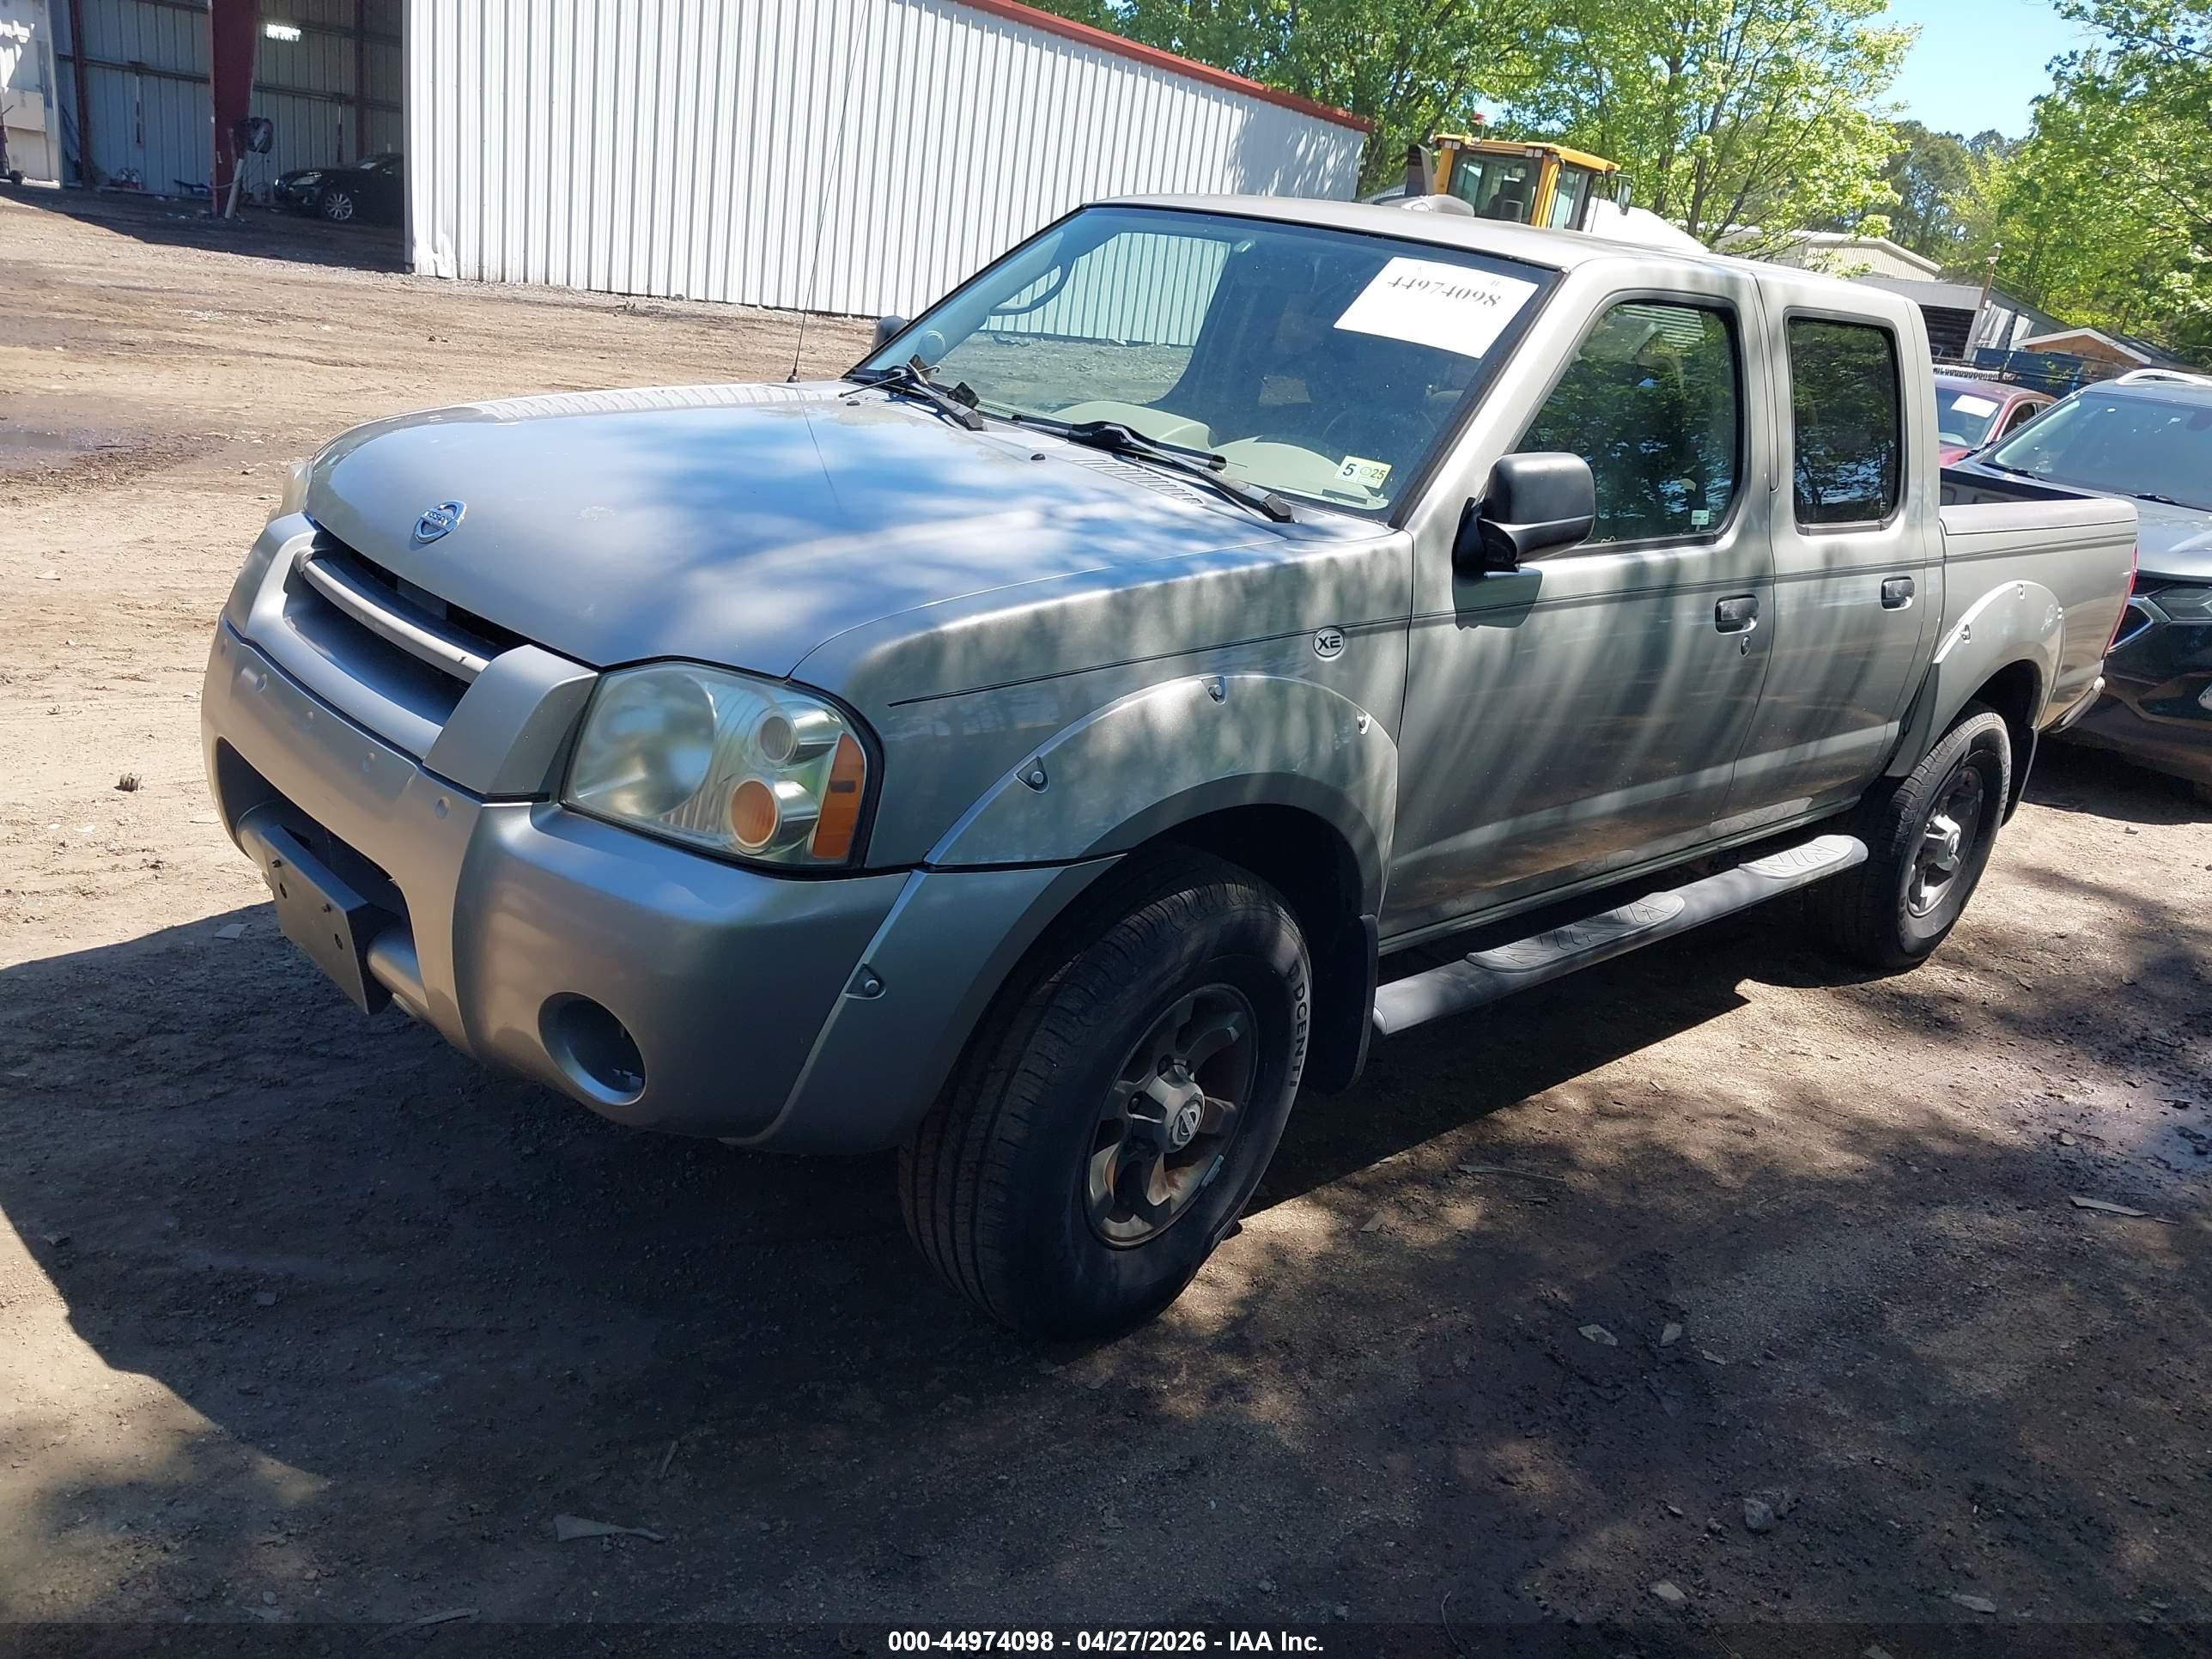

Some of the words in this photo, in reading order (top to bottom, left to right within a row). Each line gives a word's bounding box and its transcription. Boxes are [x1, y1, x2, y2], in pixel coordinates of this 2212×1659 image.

[1387, 276, 1502, 307] 44974098
[1342, 463, 1357, 477] 5
[1370, 468, 1387, 480] 25
[1317, 635, 1341, 650] XE
